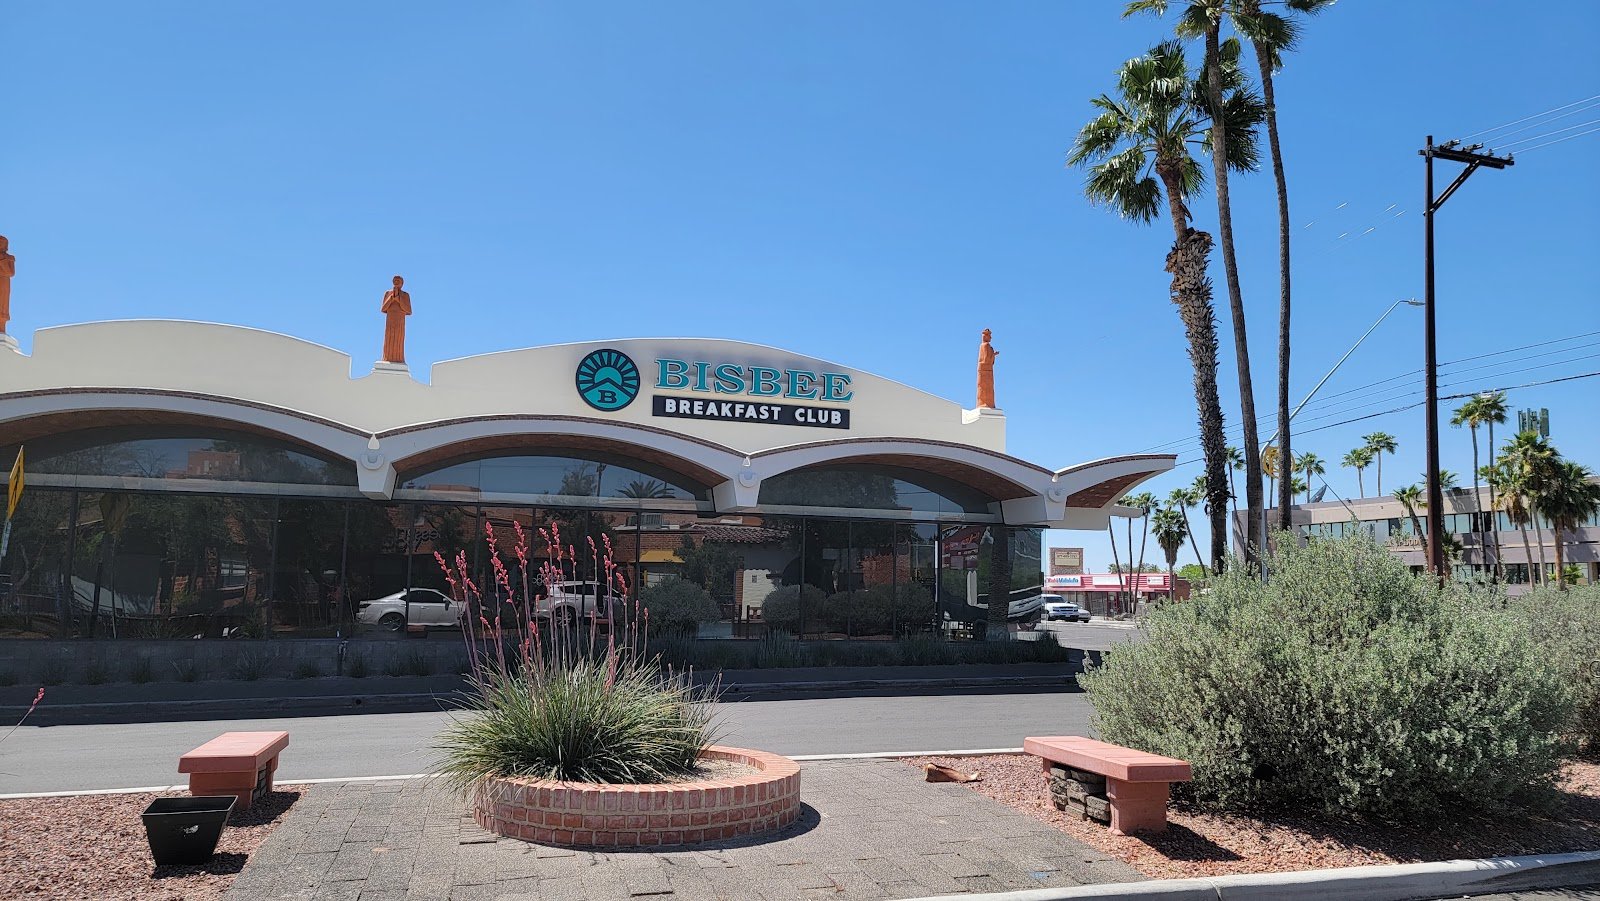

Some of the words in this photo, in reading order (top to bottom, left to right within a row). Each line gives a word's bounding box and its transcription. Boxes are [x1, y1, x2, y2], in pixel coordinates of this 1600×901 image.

[653, 358, 853, 403] BISBEE
[597, 389, 618, 404] B
[664, 398, 782, 421] BREAKFAST
[794, 408, 842, 425] CLUB
